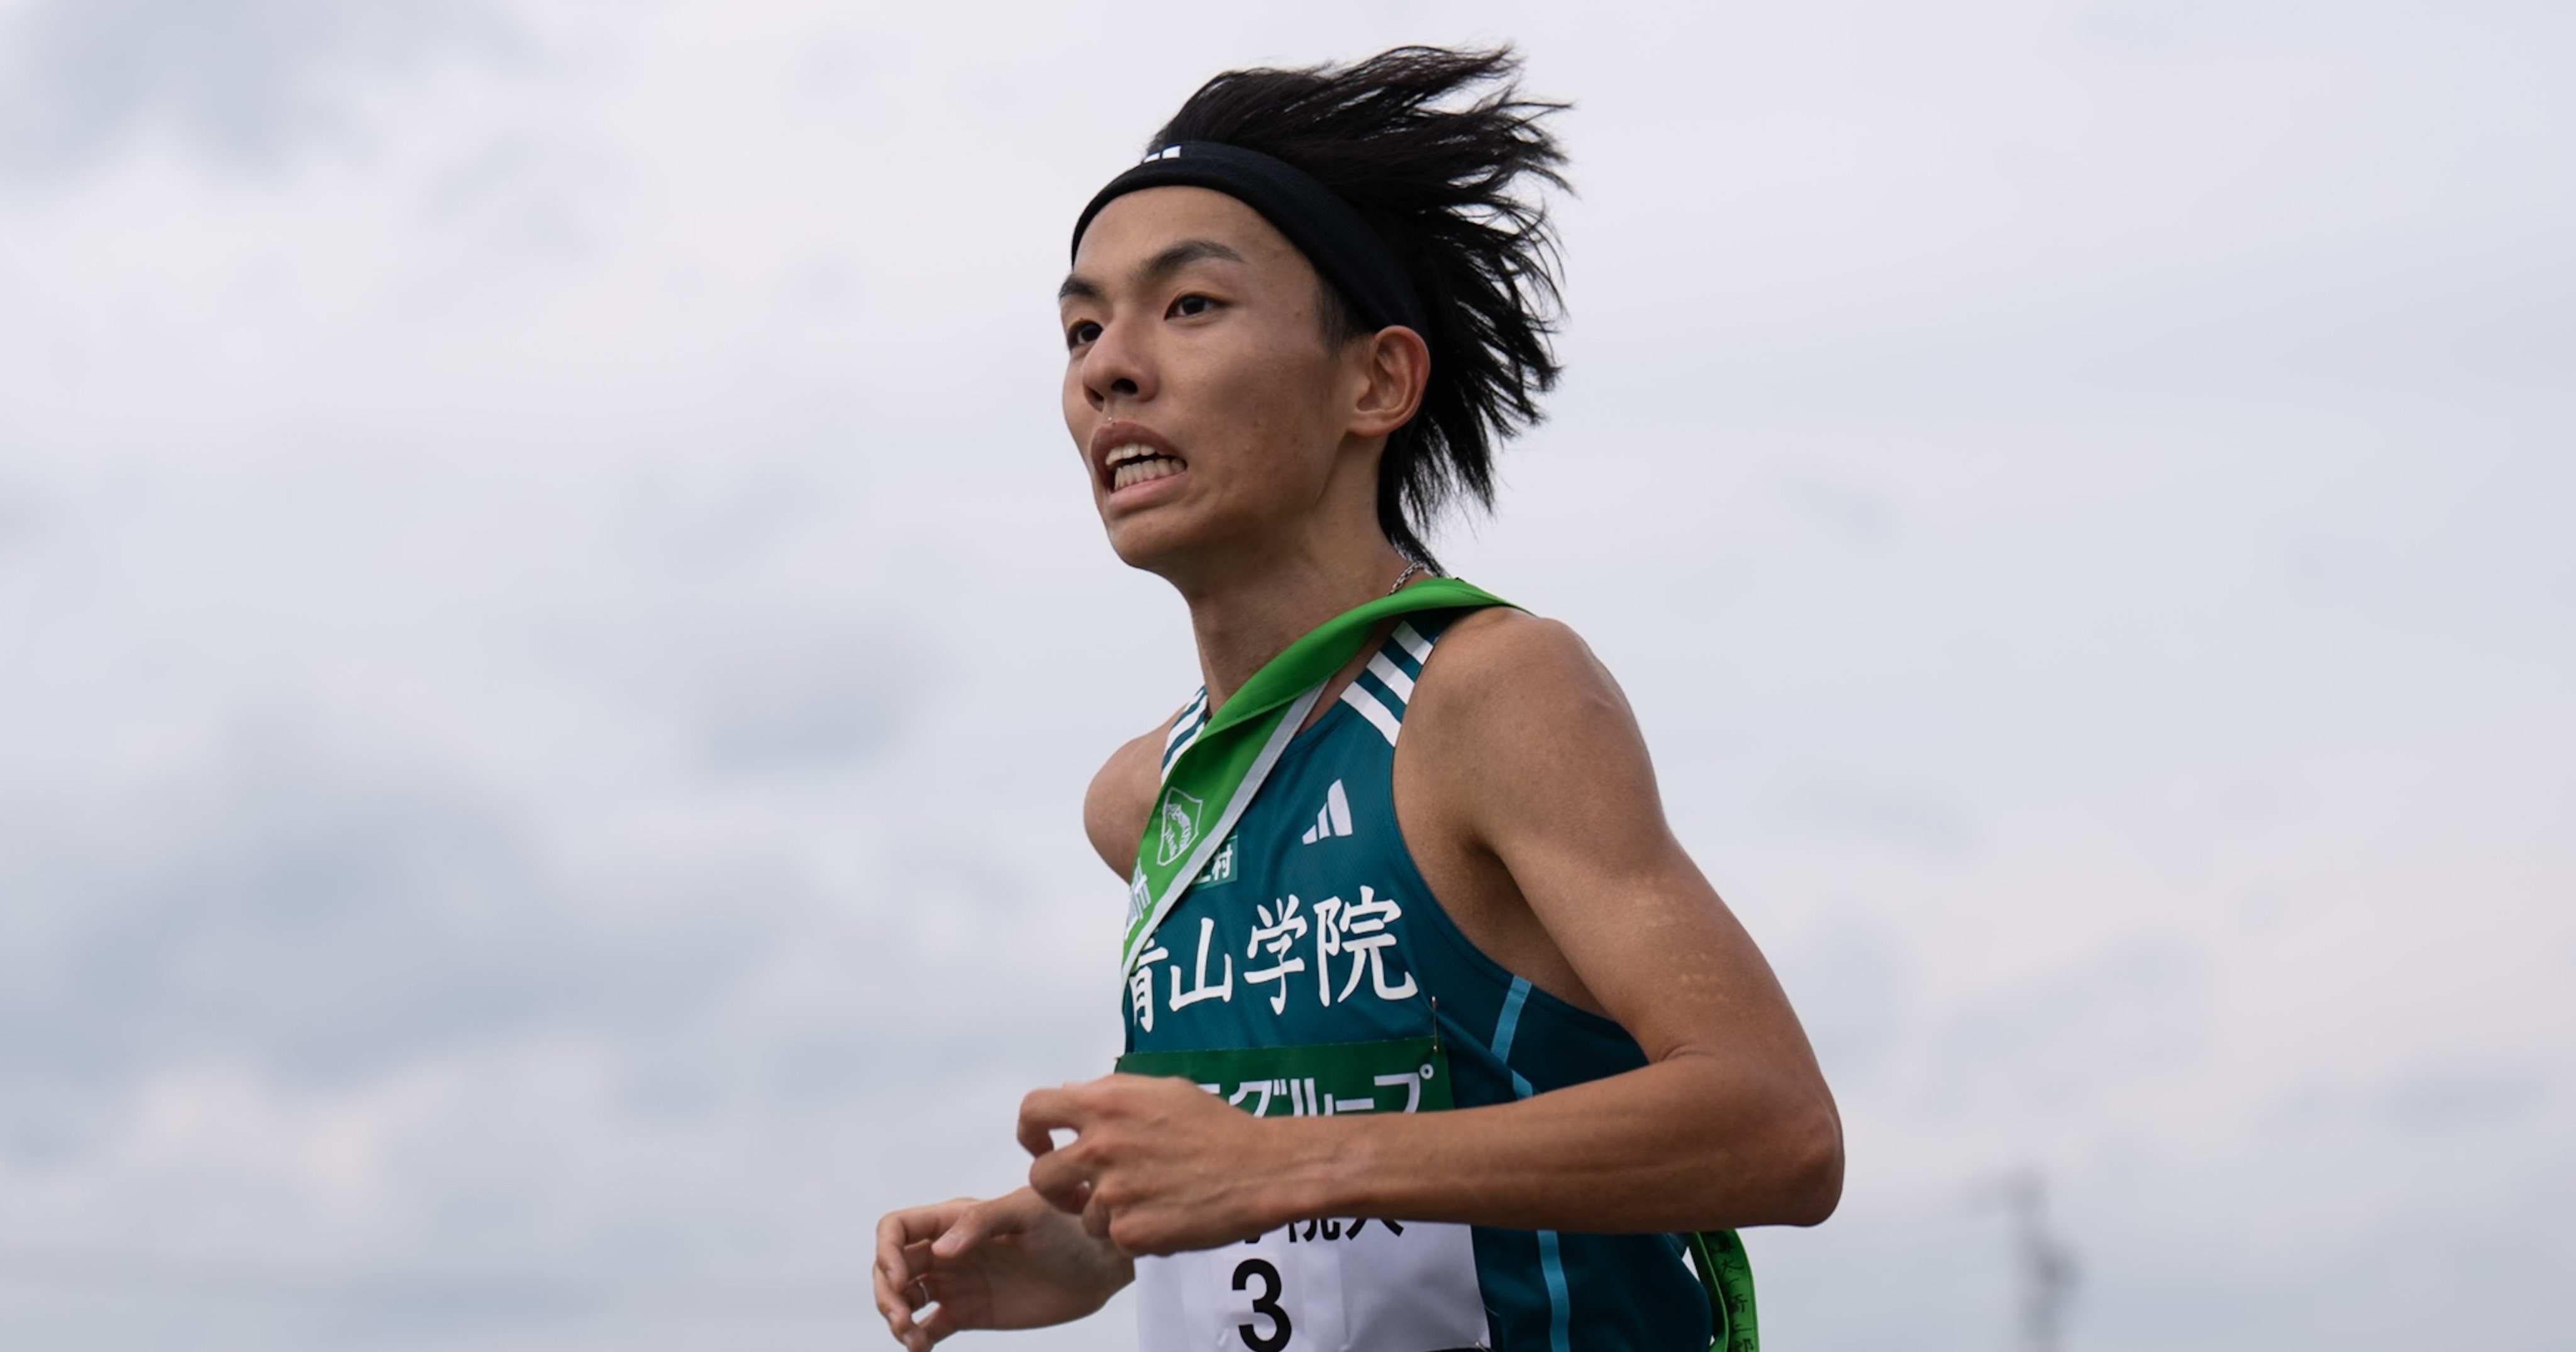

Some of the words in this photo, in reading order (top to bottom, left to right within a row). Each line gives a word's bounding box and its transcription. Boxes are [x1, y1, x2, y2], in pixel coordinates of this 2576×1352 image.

[1197, 1063, 1435, 1117] グループ
[1231, 1258, 1292, 1352] 3
